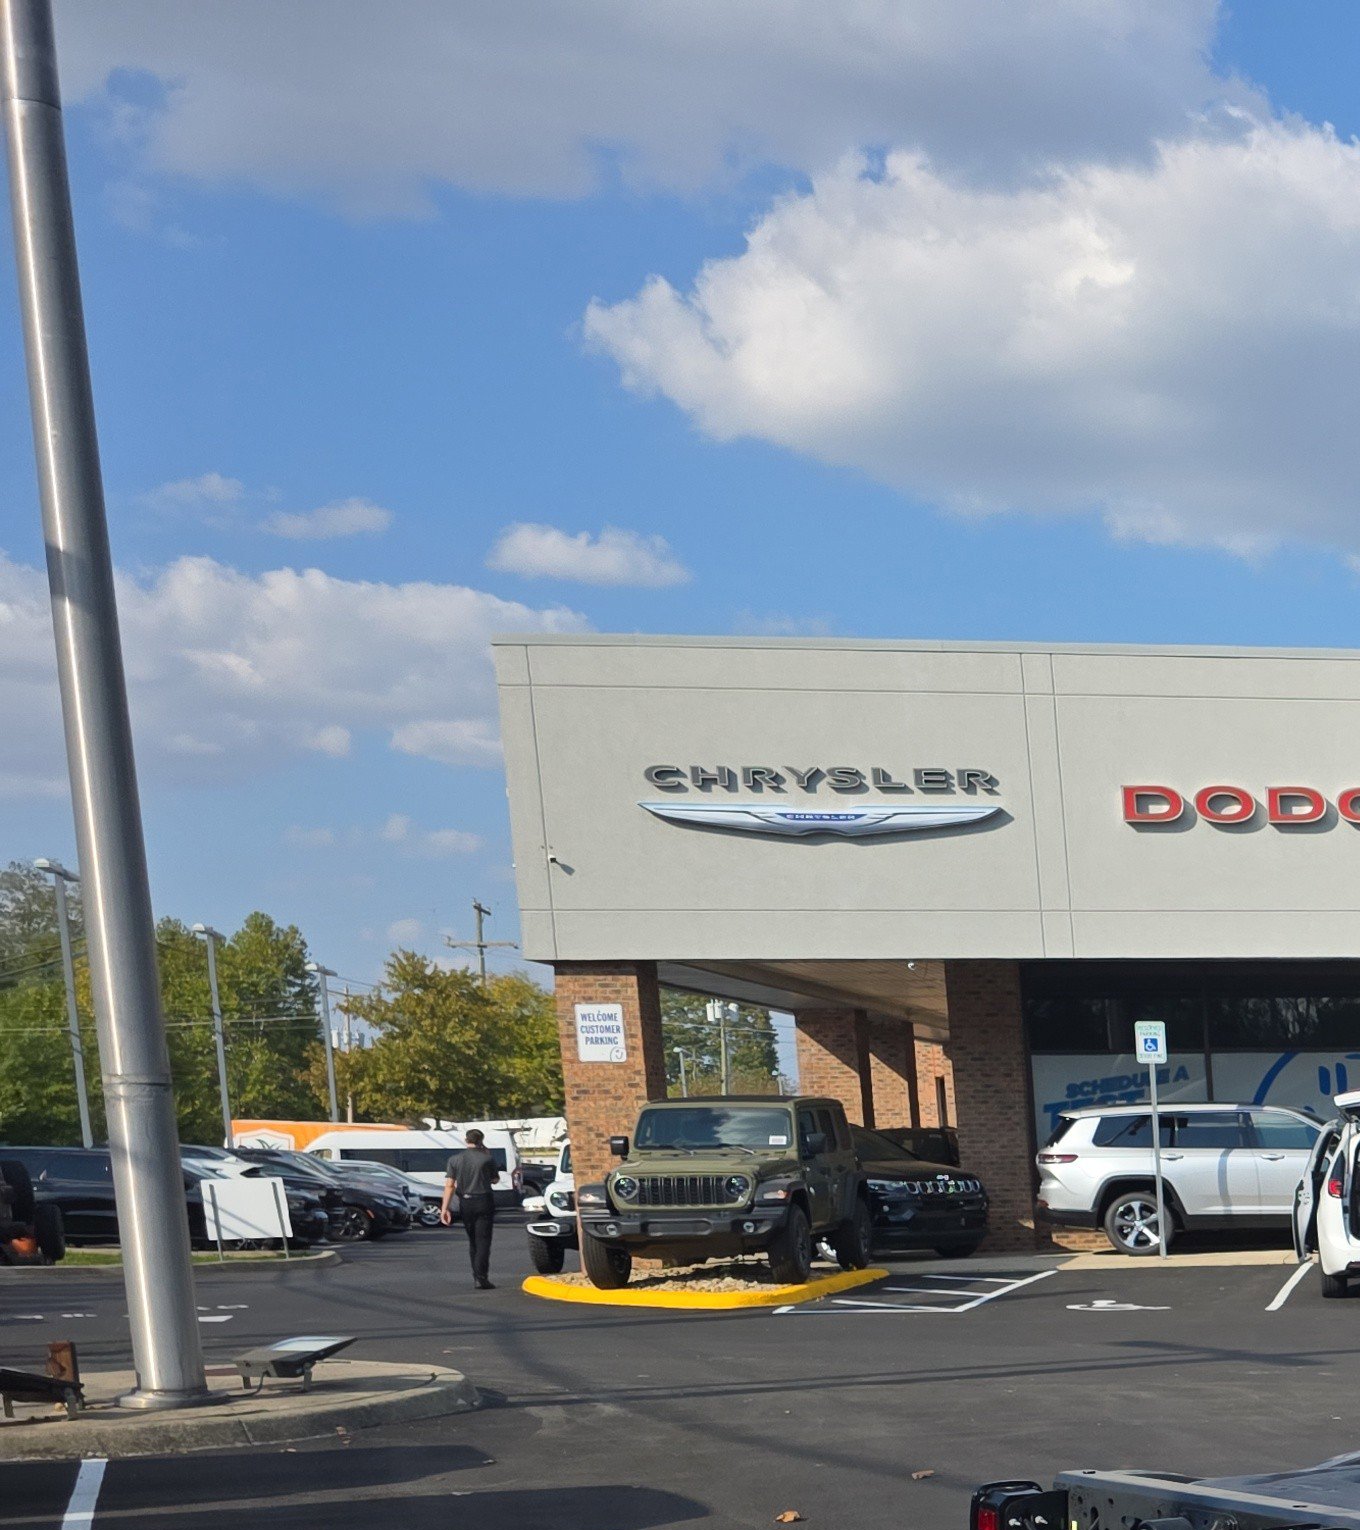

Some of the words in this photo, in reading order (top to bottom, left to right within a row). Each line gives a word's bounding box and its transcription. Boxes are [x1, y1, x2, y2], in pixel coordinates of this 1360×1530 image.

[643, 763, 1000, 794] CHRYSLER
[580, 1012, 618, 1022] WELCOME
[580, 1024, 621, 1035] CUSTOMER
[585, 1036, 619, 1046] PARKING
